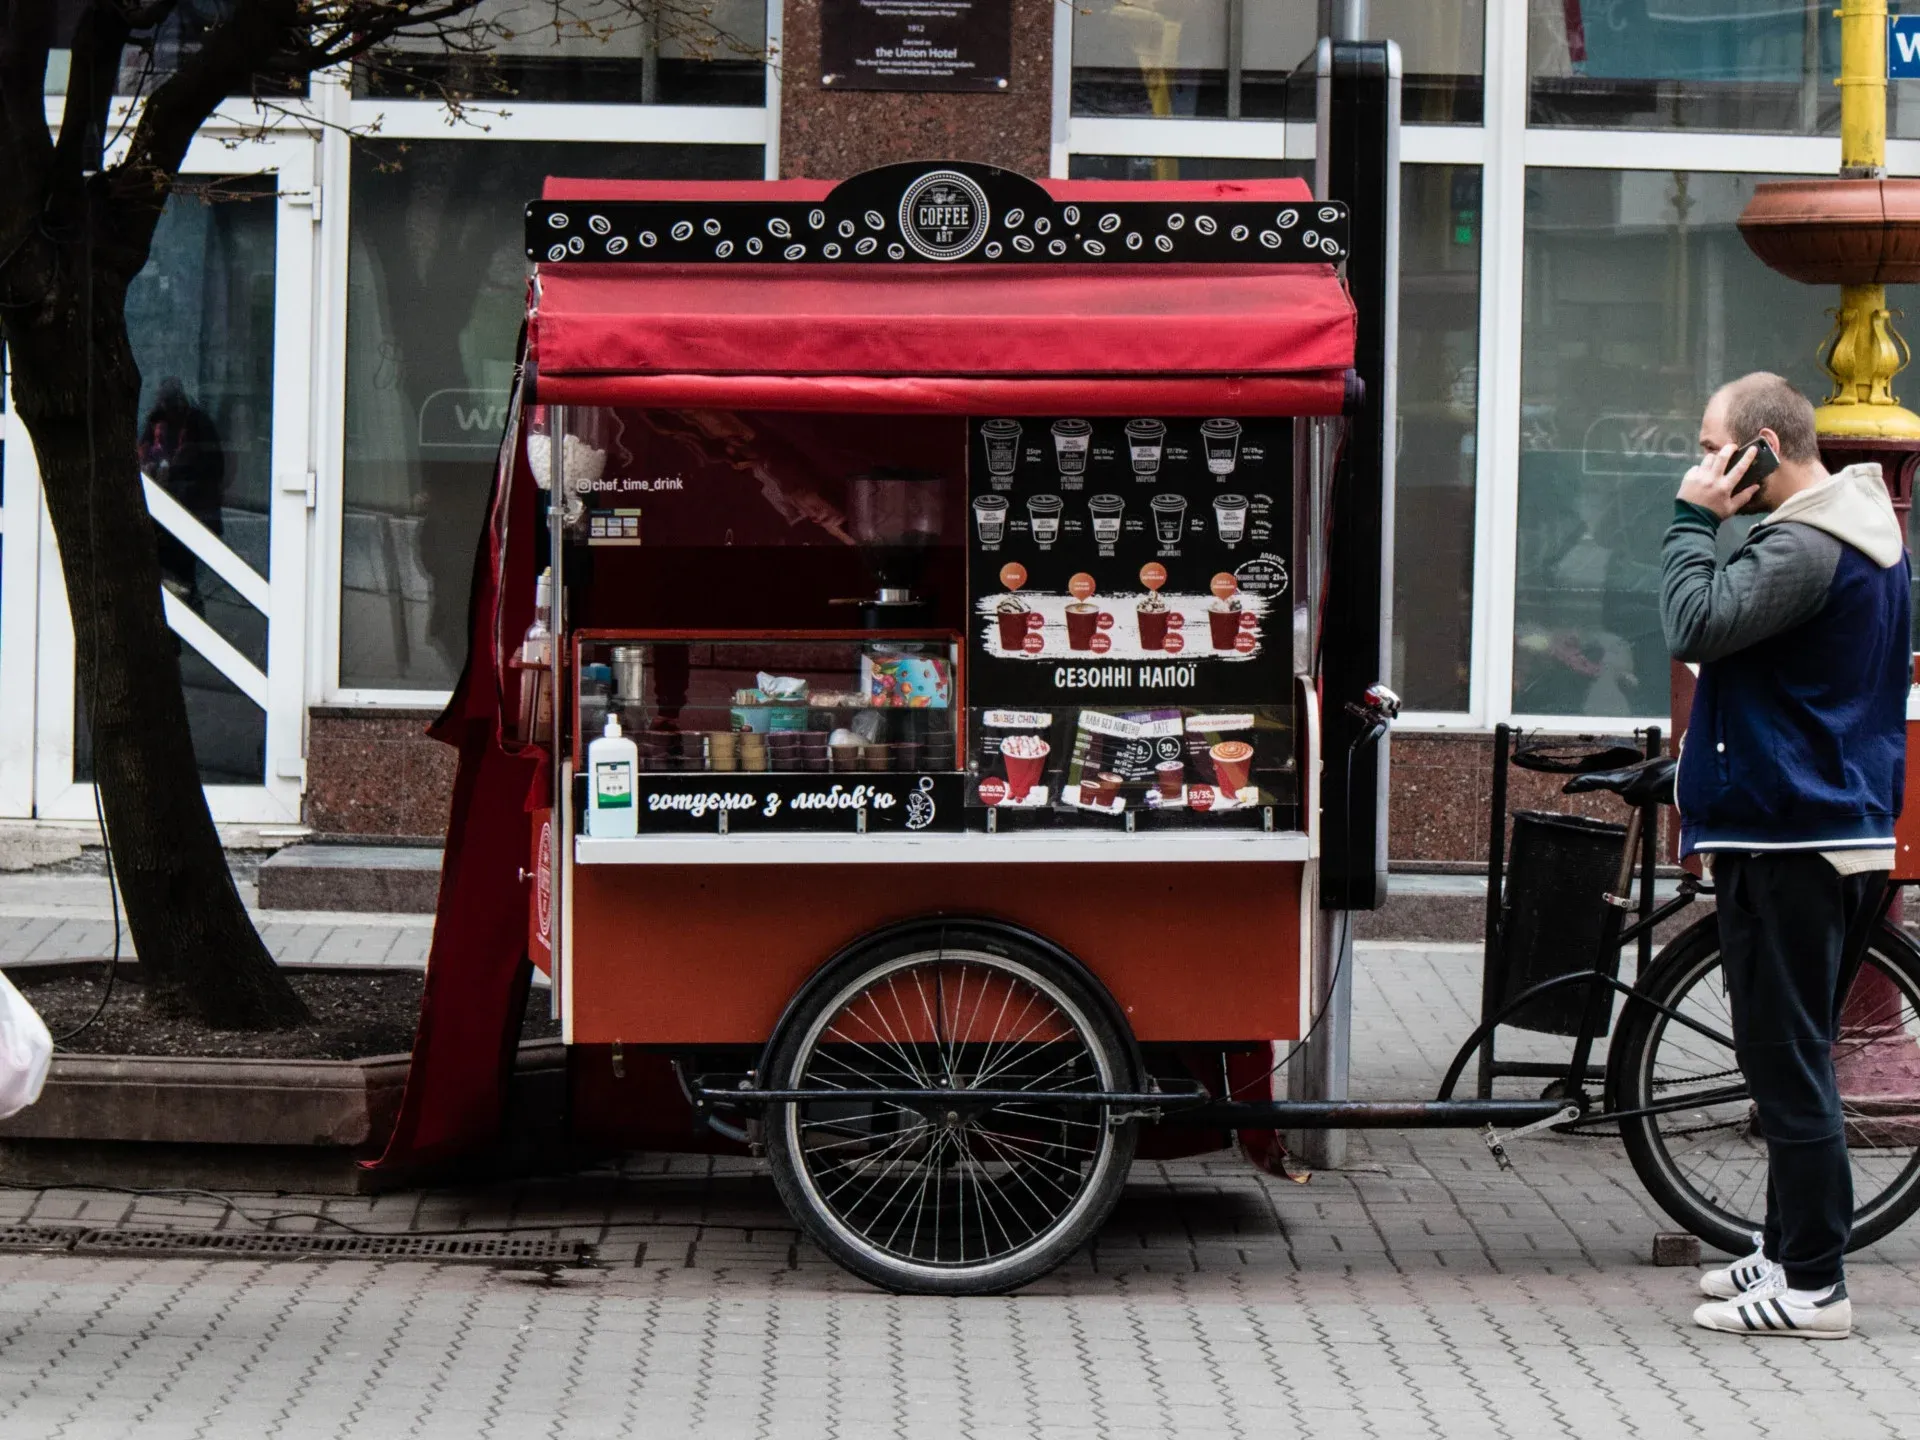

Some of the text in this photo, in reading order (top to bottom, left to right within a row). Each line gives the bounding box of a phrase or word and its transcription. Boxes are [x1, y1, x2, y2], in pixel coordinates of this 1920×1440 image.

[875, 47, 957, 59] the Union Hotel
[919, 206, 969, 226] COFFEE
[935, 231, 954, 243] ART
[592, 477, 684, 493] chef_time_drink
[1054, 663, 1198, 688] СЕЗОННІ НАПОЇ
[992, 713, 1045, 725] BABY CHINO
[648, 791, 757, 817] готуємо
[762, 791, 782, 817] з
